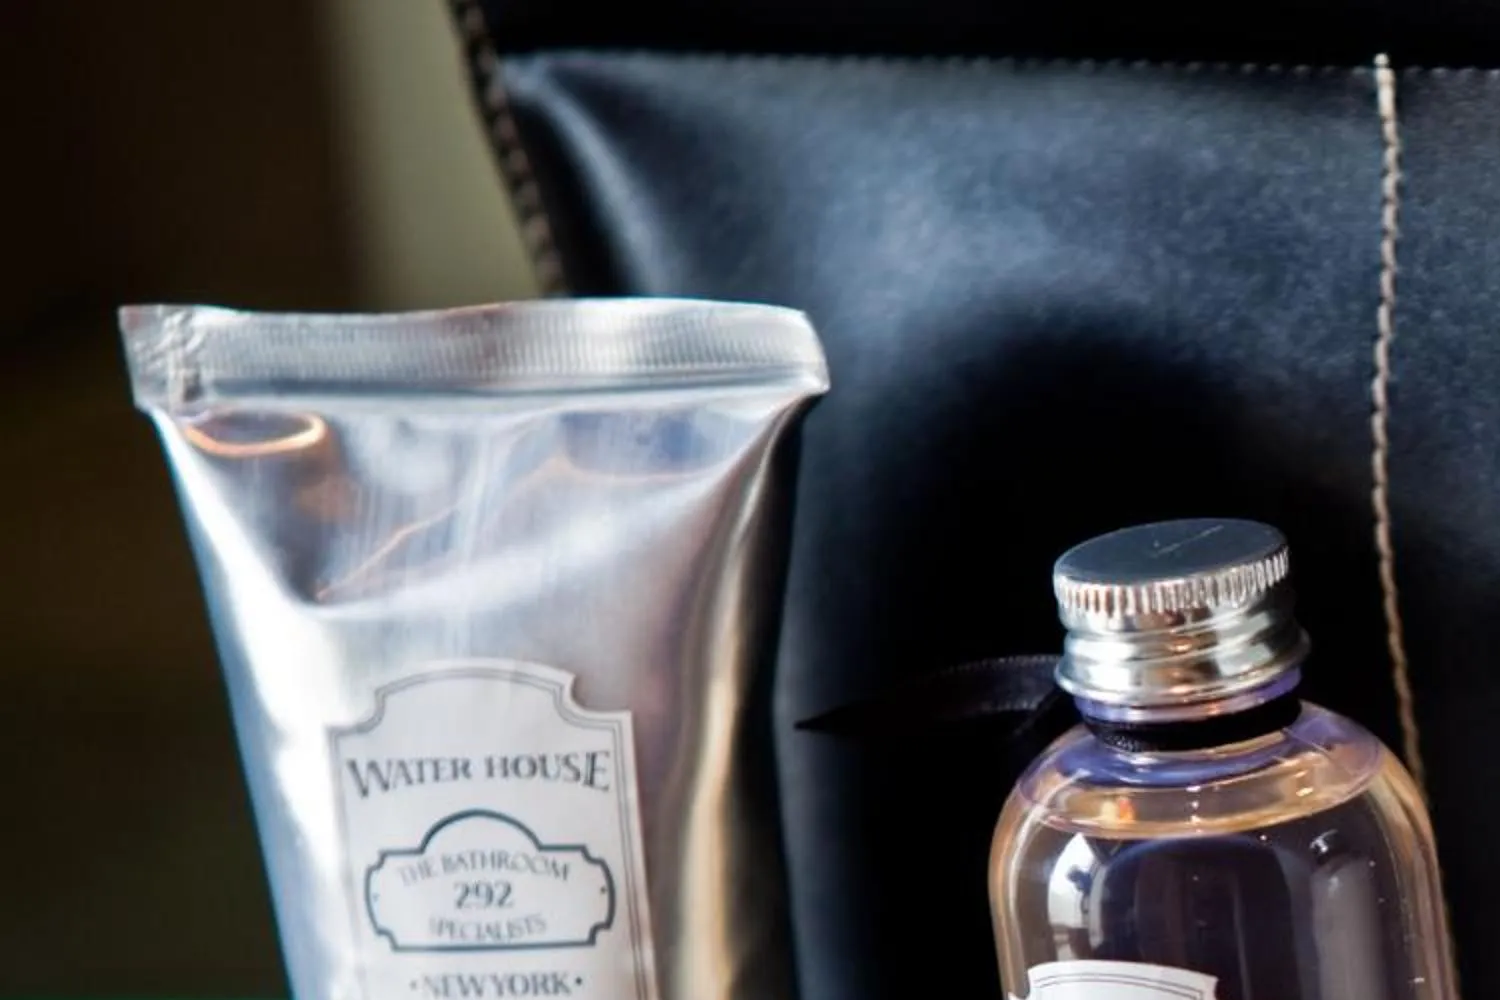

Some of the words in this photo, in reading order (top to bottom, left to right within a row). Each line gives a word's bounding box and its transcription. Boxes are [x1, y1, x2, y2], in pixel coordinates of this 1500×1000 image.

[346, 757, 472, 799] WATER
[484, 750, 611, 793] HOUSE
[398, 858, 440, 888] THE
[441, 849, 571, 882] BATHROOM
[453, 881, 514, 911] 292
